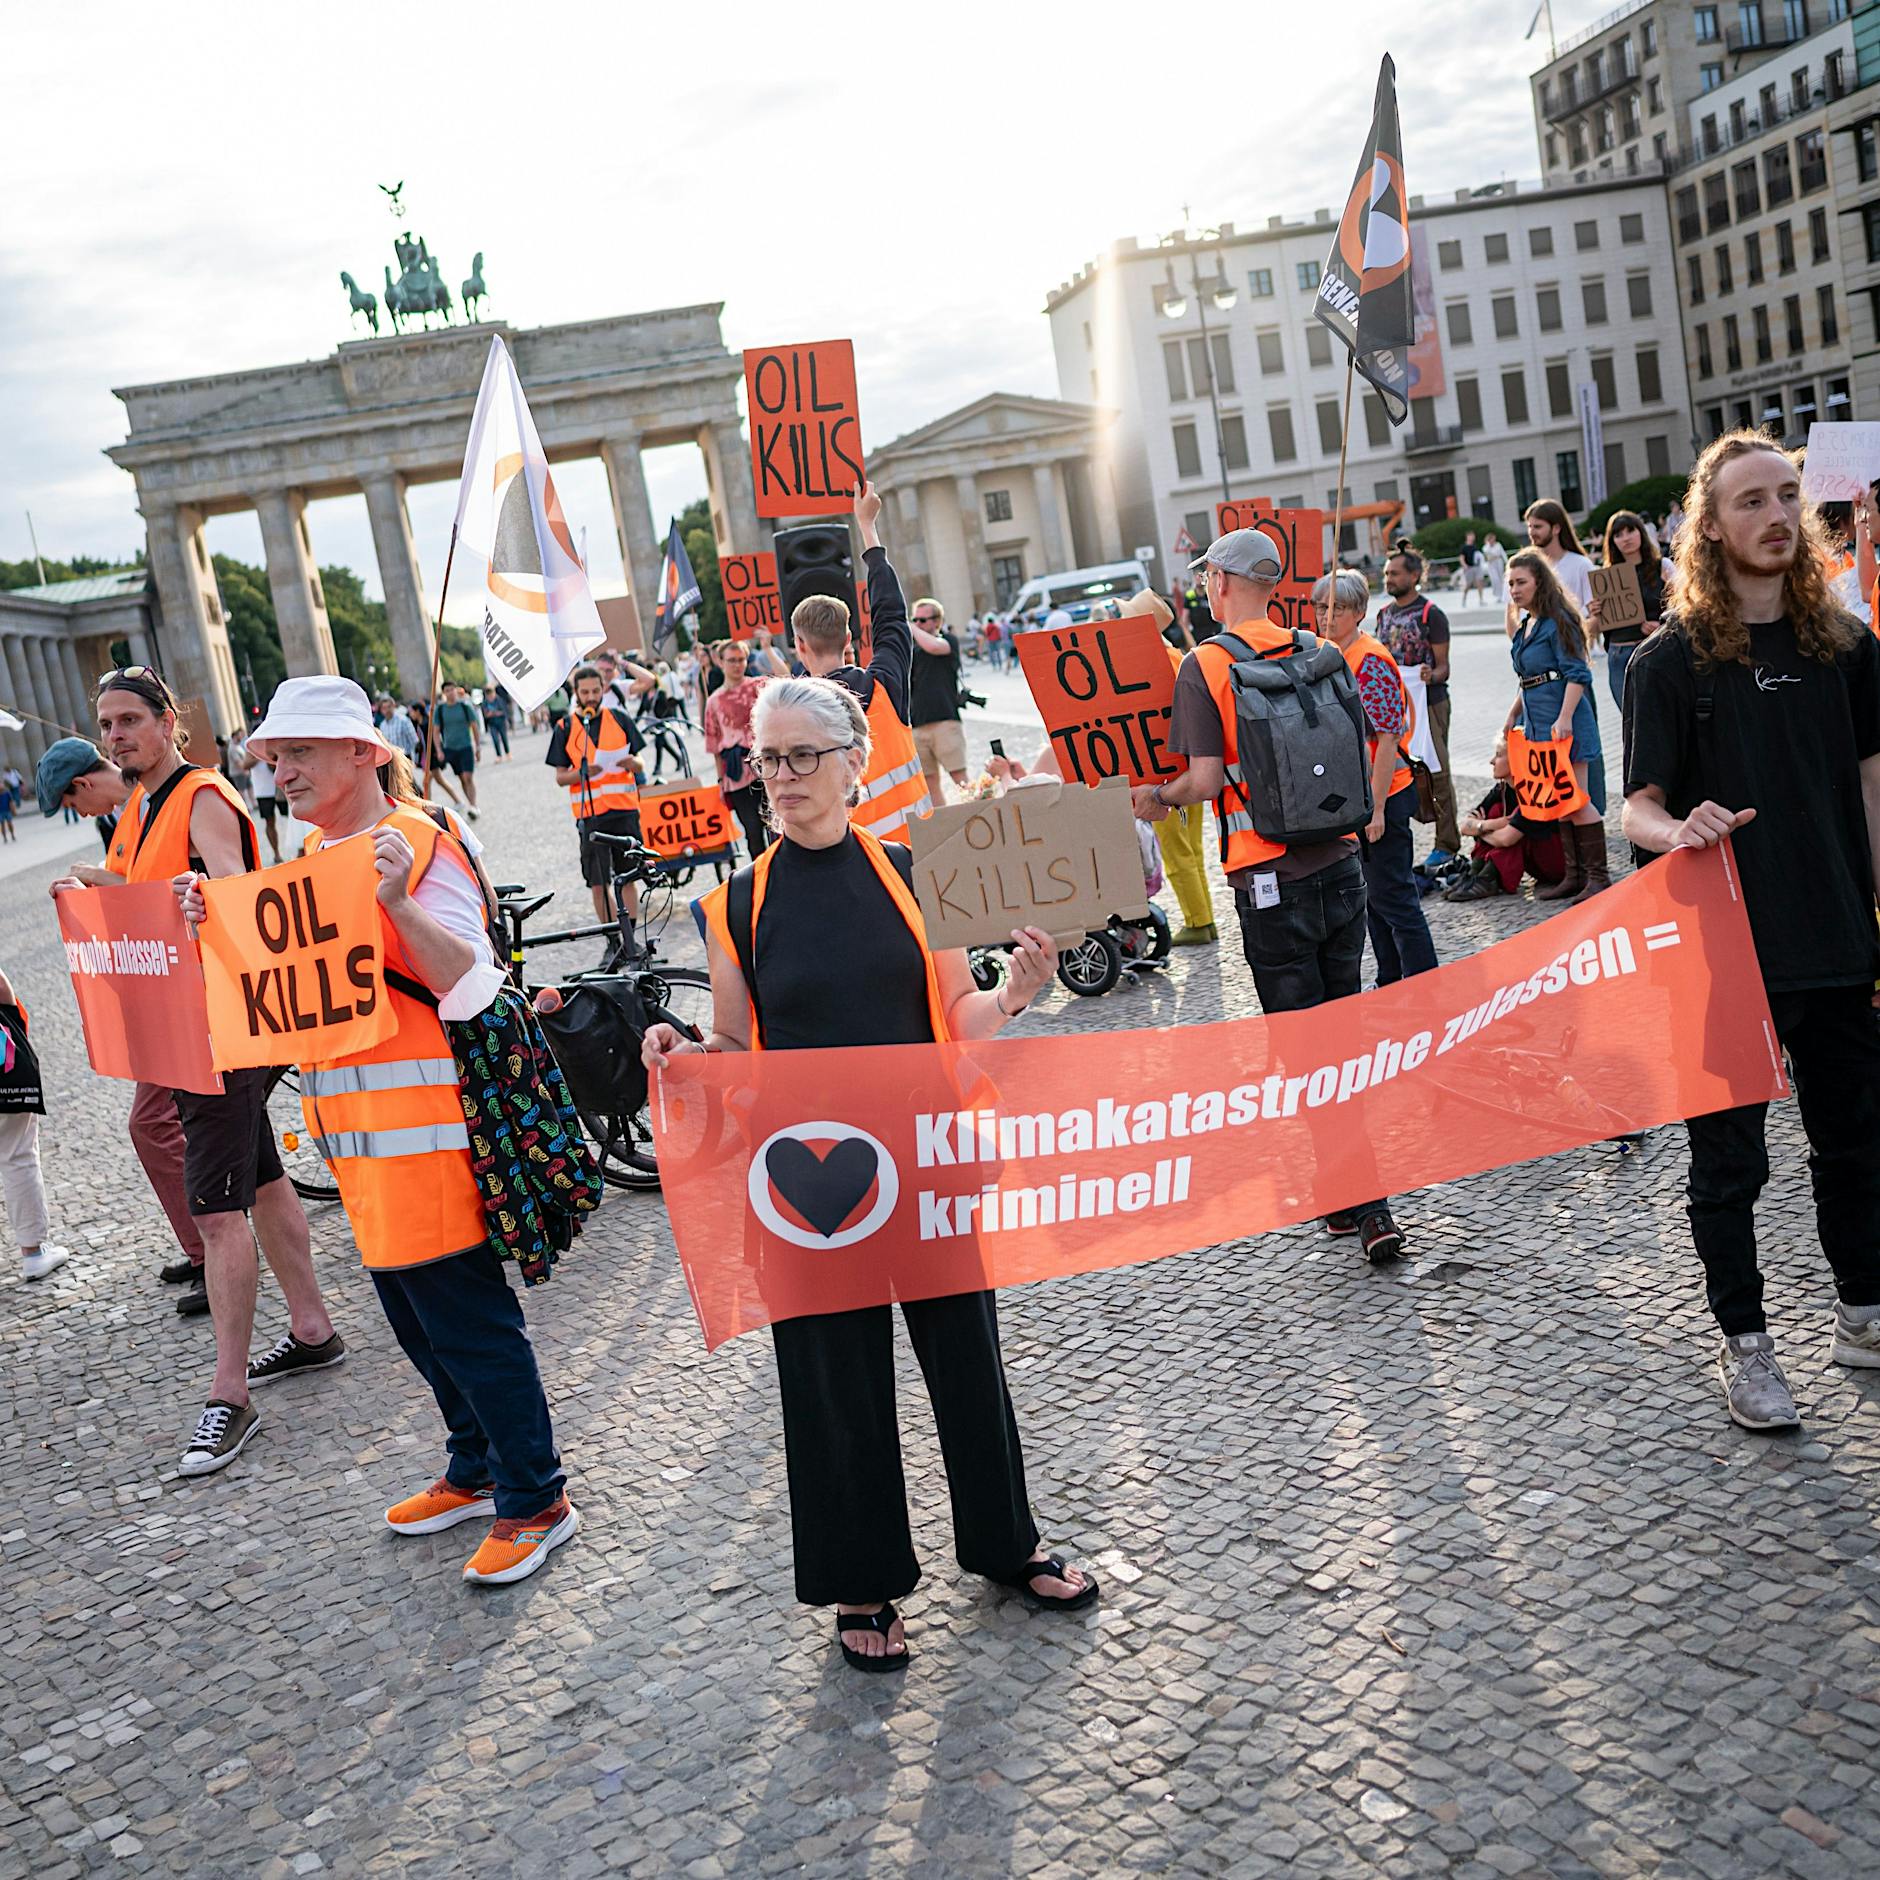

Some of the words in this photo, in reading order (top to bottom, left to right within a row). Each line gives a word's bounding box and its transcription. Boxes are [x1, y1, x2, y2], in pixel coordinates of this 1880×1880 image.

[755, 352, 844, 414] OIL
[757, 416, 865, 497] KILLS
[725, 556, 775, 592] ÖL
[1594, 568, 1631, 596] OIL
[1267, 592, 1318, 632] ÖTE
[1600, 592, 1639, 625] KILLS
[485, 604, 535, 681] RATION
[1051, 630, 1151, 700] ÖL
[647, 814, 723, 847] KILLS
[659, 796, 705, 820] OIL
[964, 804, 1044, 850] OIL
[255, 876, 339, 954] OIL
[63, 934, 113, 978] strophe
[111, 933, 169, 976] zulassen
[240, 944, 376, 1037] KILLS
[915, 1030, 1432, 1168] Klimakatastrophe
[1435, 926, 1637, 1056] zulassen
[918, 1155, 1192, 1241] kriminell
